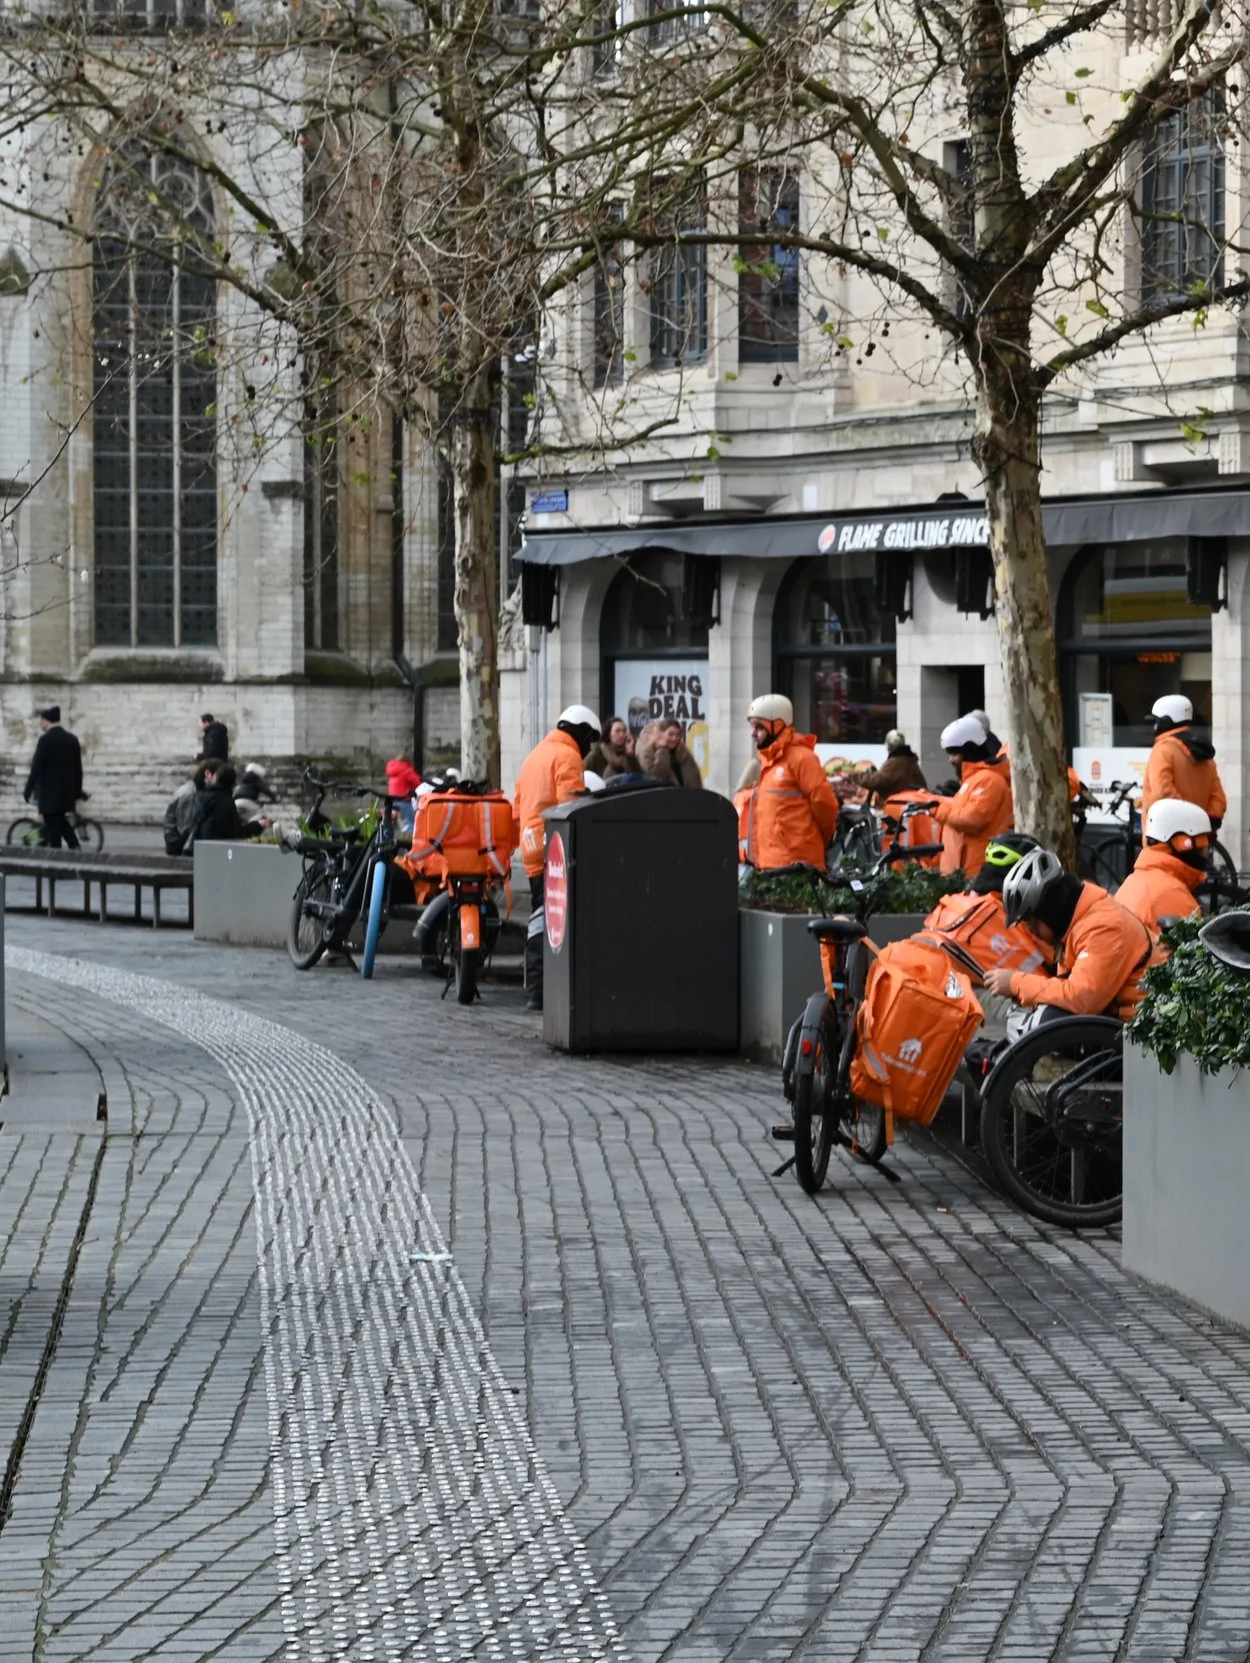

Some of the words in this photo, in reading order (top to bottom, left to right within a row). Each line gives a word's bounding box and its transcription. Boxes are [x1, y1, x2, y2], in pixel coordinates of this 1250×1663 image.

[838, 524, 883, 551] FLAME
[883, 519, 949, 548] GRILLING
[649, 675, 703, 697] KING
[649, 695, 706, 720] DEAL
